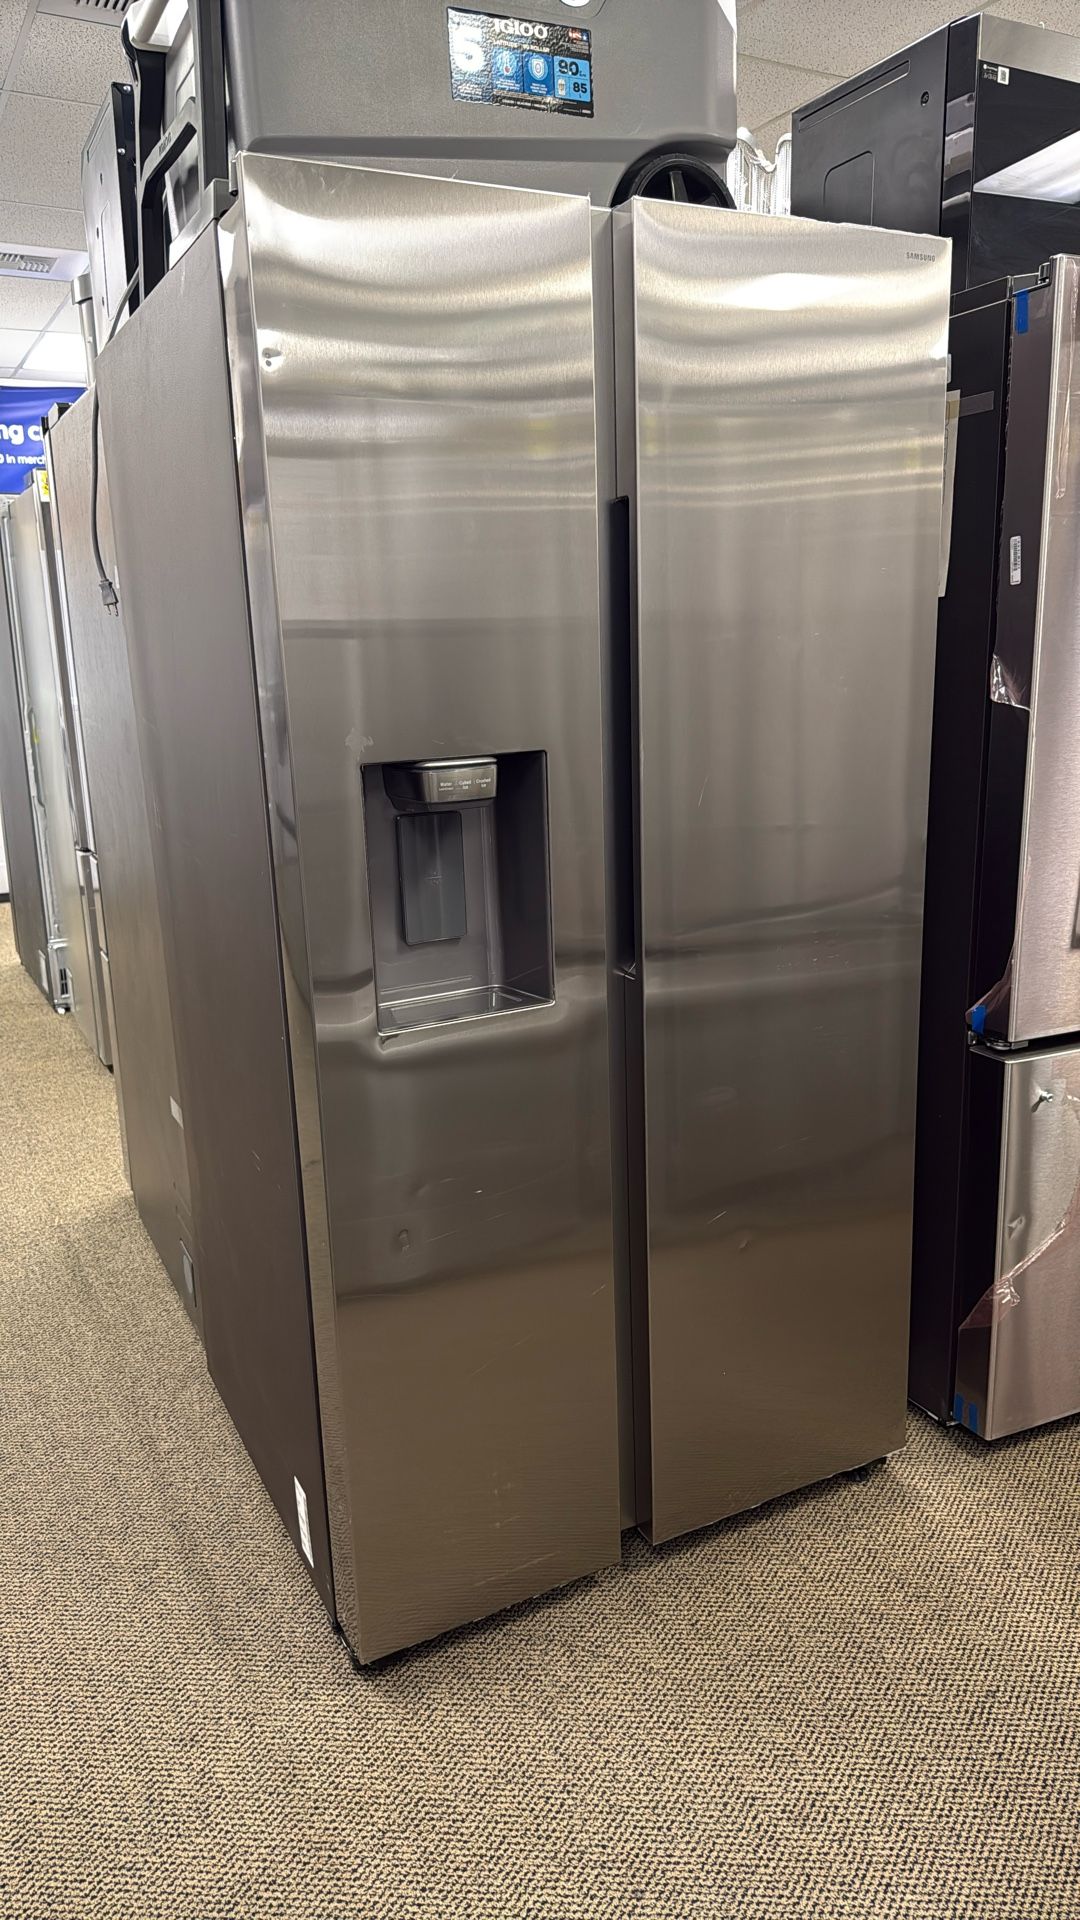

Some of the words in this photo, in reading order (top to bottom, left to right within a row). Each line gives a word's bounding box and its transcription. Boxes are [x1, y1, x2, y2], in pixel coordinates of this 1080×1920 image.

[558, 59, 580, 76] 90
[572, 82, 588, 94] 85
[906, 251, 936, 262] SAMSUNG
